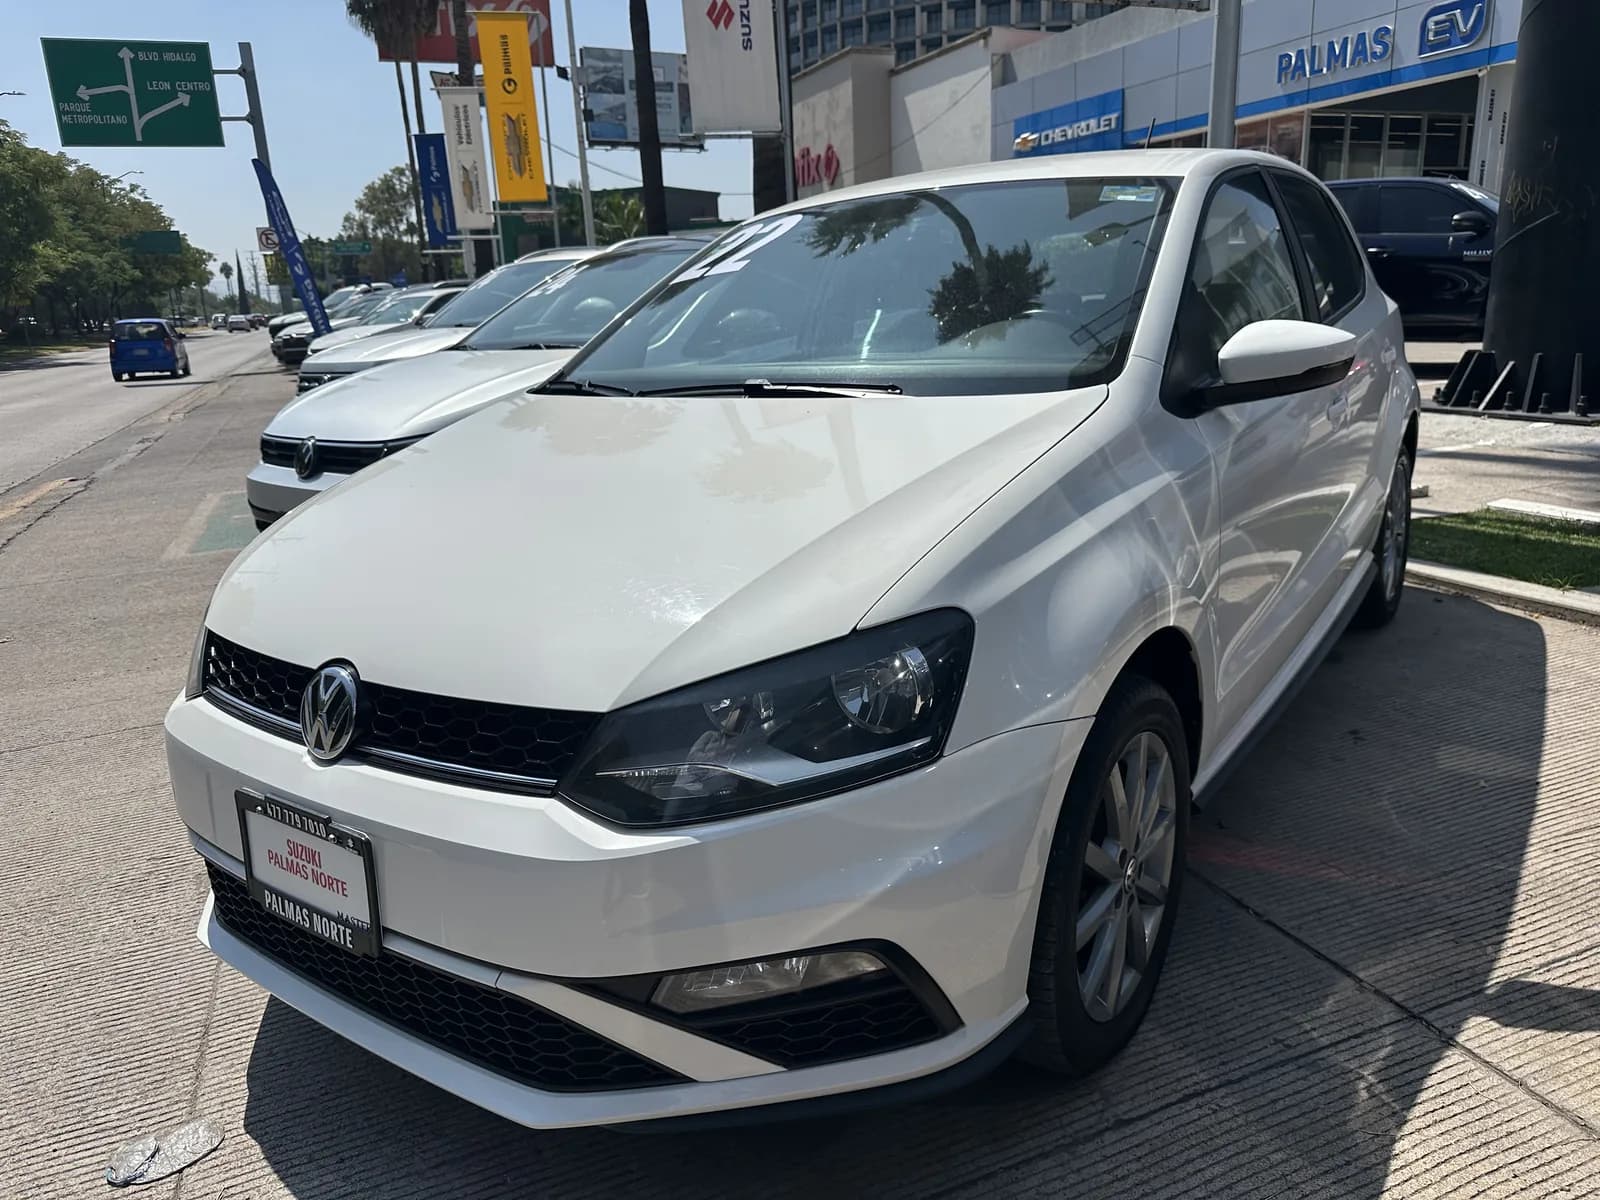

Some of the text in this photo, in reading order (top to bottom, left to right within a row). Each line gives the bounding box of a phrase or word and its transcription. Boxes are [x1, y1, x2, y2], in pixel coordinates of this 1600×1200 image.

[1427, 3, 1483, 44] EV
[137, 51, 197, 62] BLVD HIDALGO
[1277, 25, 1393, 84] PALMAS
[146, 81, 211, 91] LEON CENTRO
[59, 102, 92, 112] PARQUE
[61, 114, 128, 124] METROPOLITANO
[1041, 113, 1119, 146] CHEVROLET
[668, 214, 803, 285] 22
[283, 809, 302, 829] 779
[302, 816, 327, 839] 7010
[287, 839, 322, 869] SUZUKI
[267, 849, 349, 898] PALMAS NORTE
[264, 889, 353, 949] PALMAS NORTE
